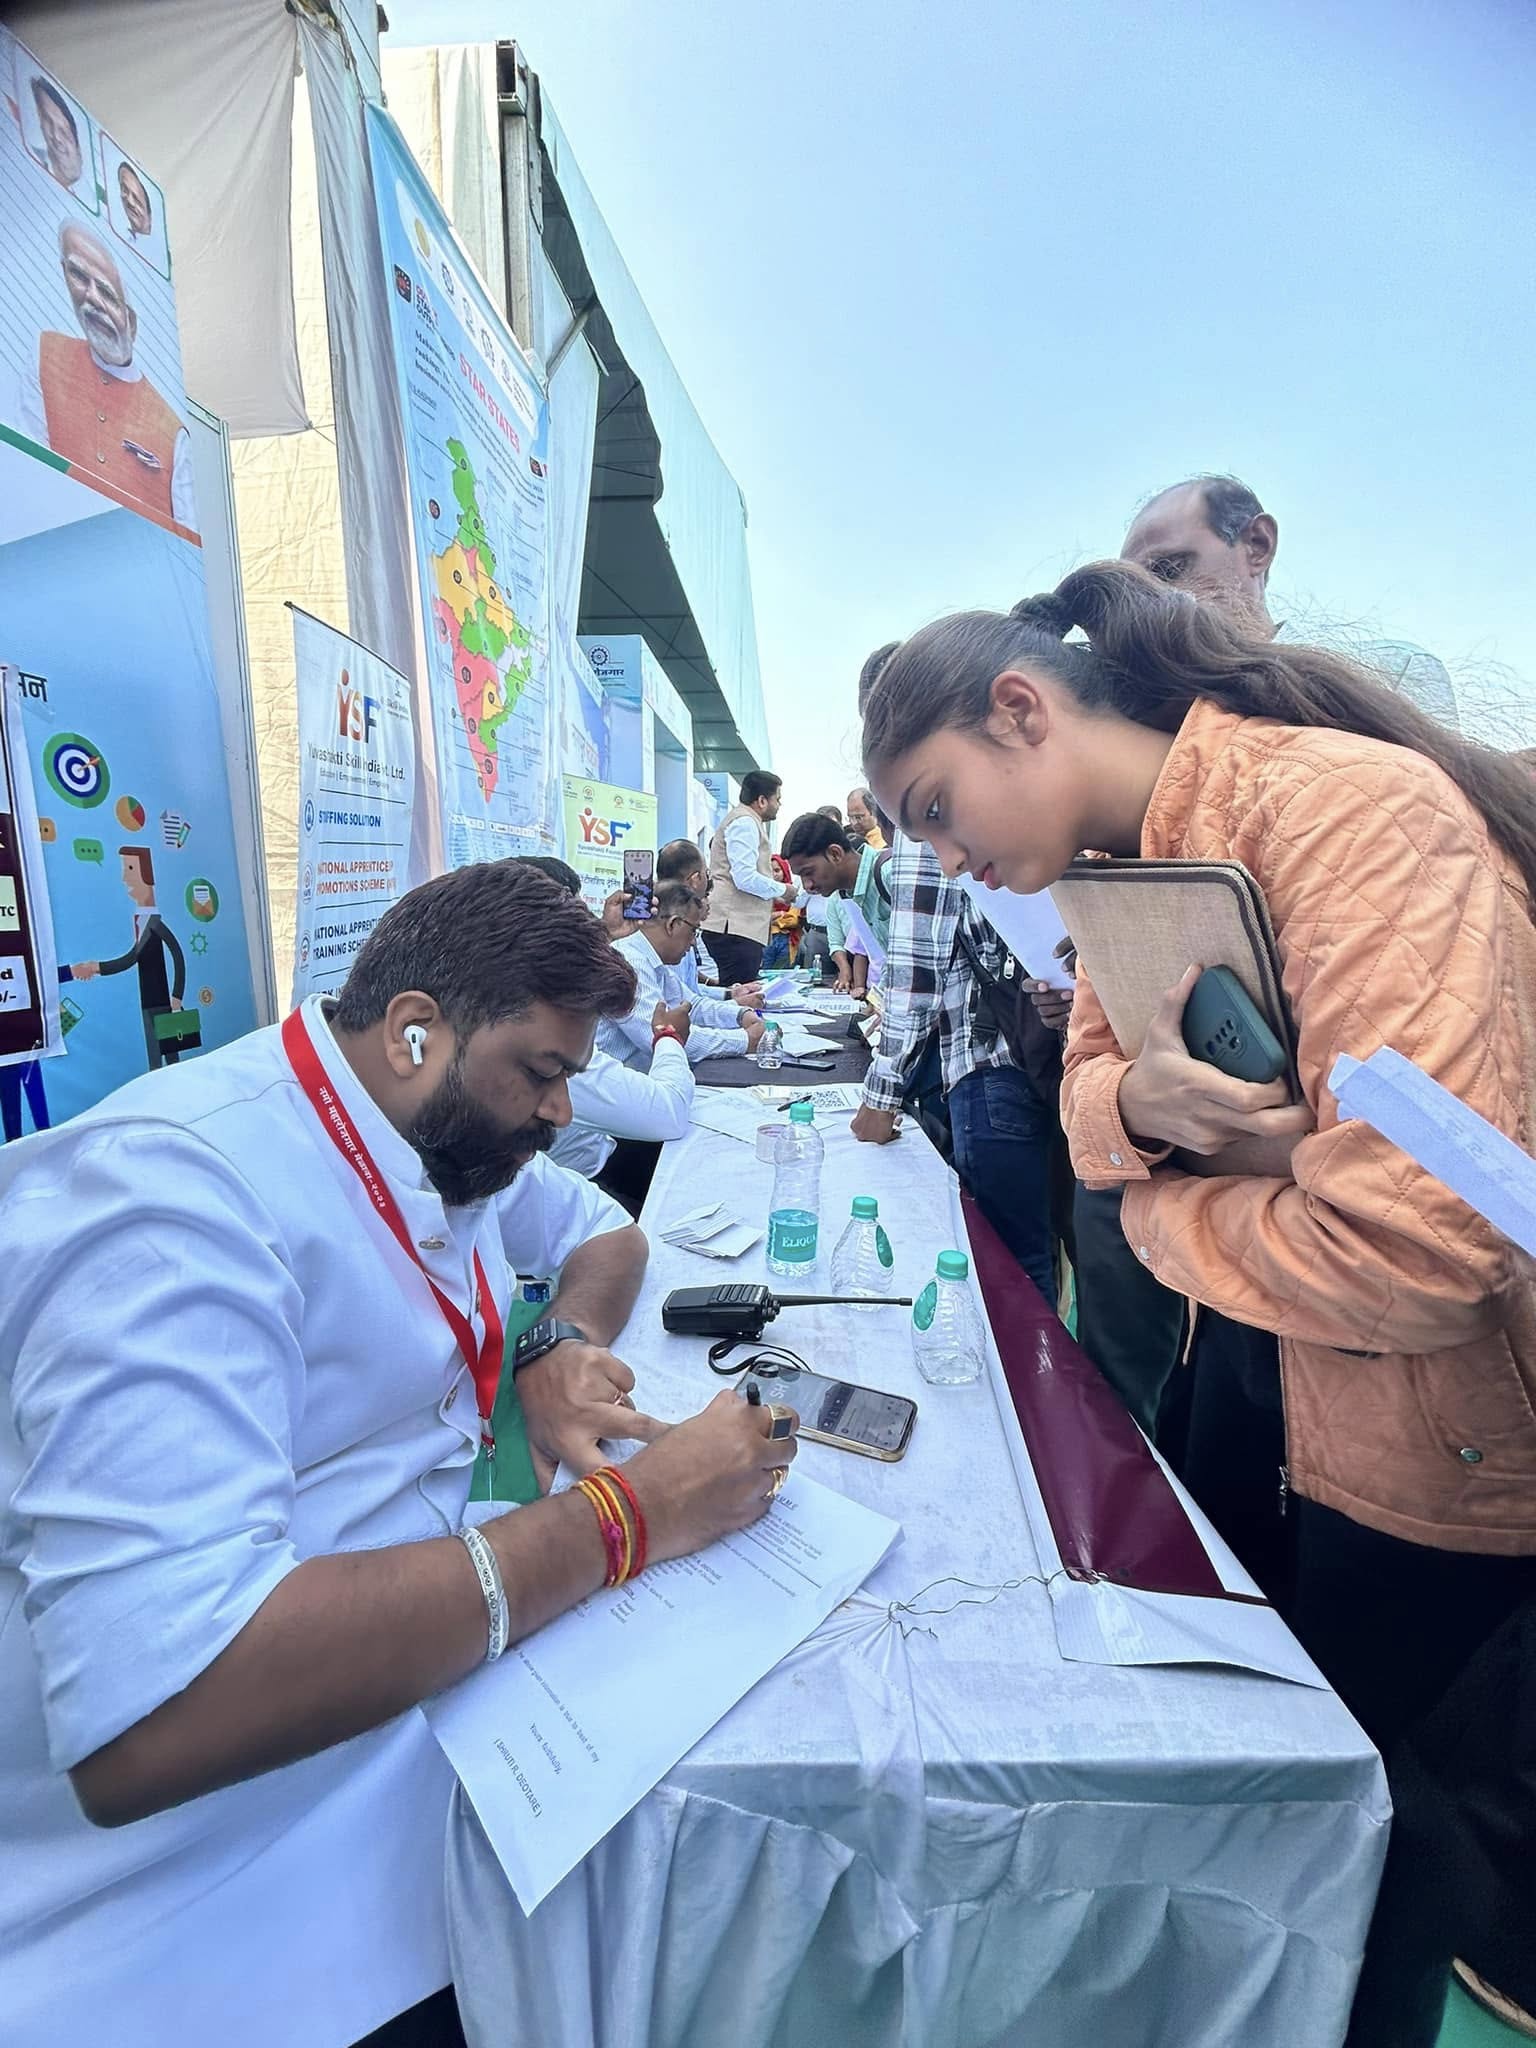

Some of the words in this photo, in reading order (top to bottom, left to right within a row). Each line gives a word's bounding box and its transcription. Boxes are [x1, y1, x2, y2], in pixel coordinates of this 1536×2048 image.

[459, 352, 488, 406] STAR
[487, 392, 520, 453] STATES
[337, 669, 381, 743] YSF
[308, 742, 343, 765] Yuvaskti
[391, 765, 406, 780] Ltd.
[579, 808, 632, 846] YSF
[317, 860, 349, 876] NTIONAL
[319, 1086, 334, 1105] नमो
